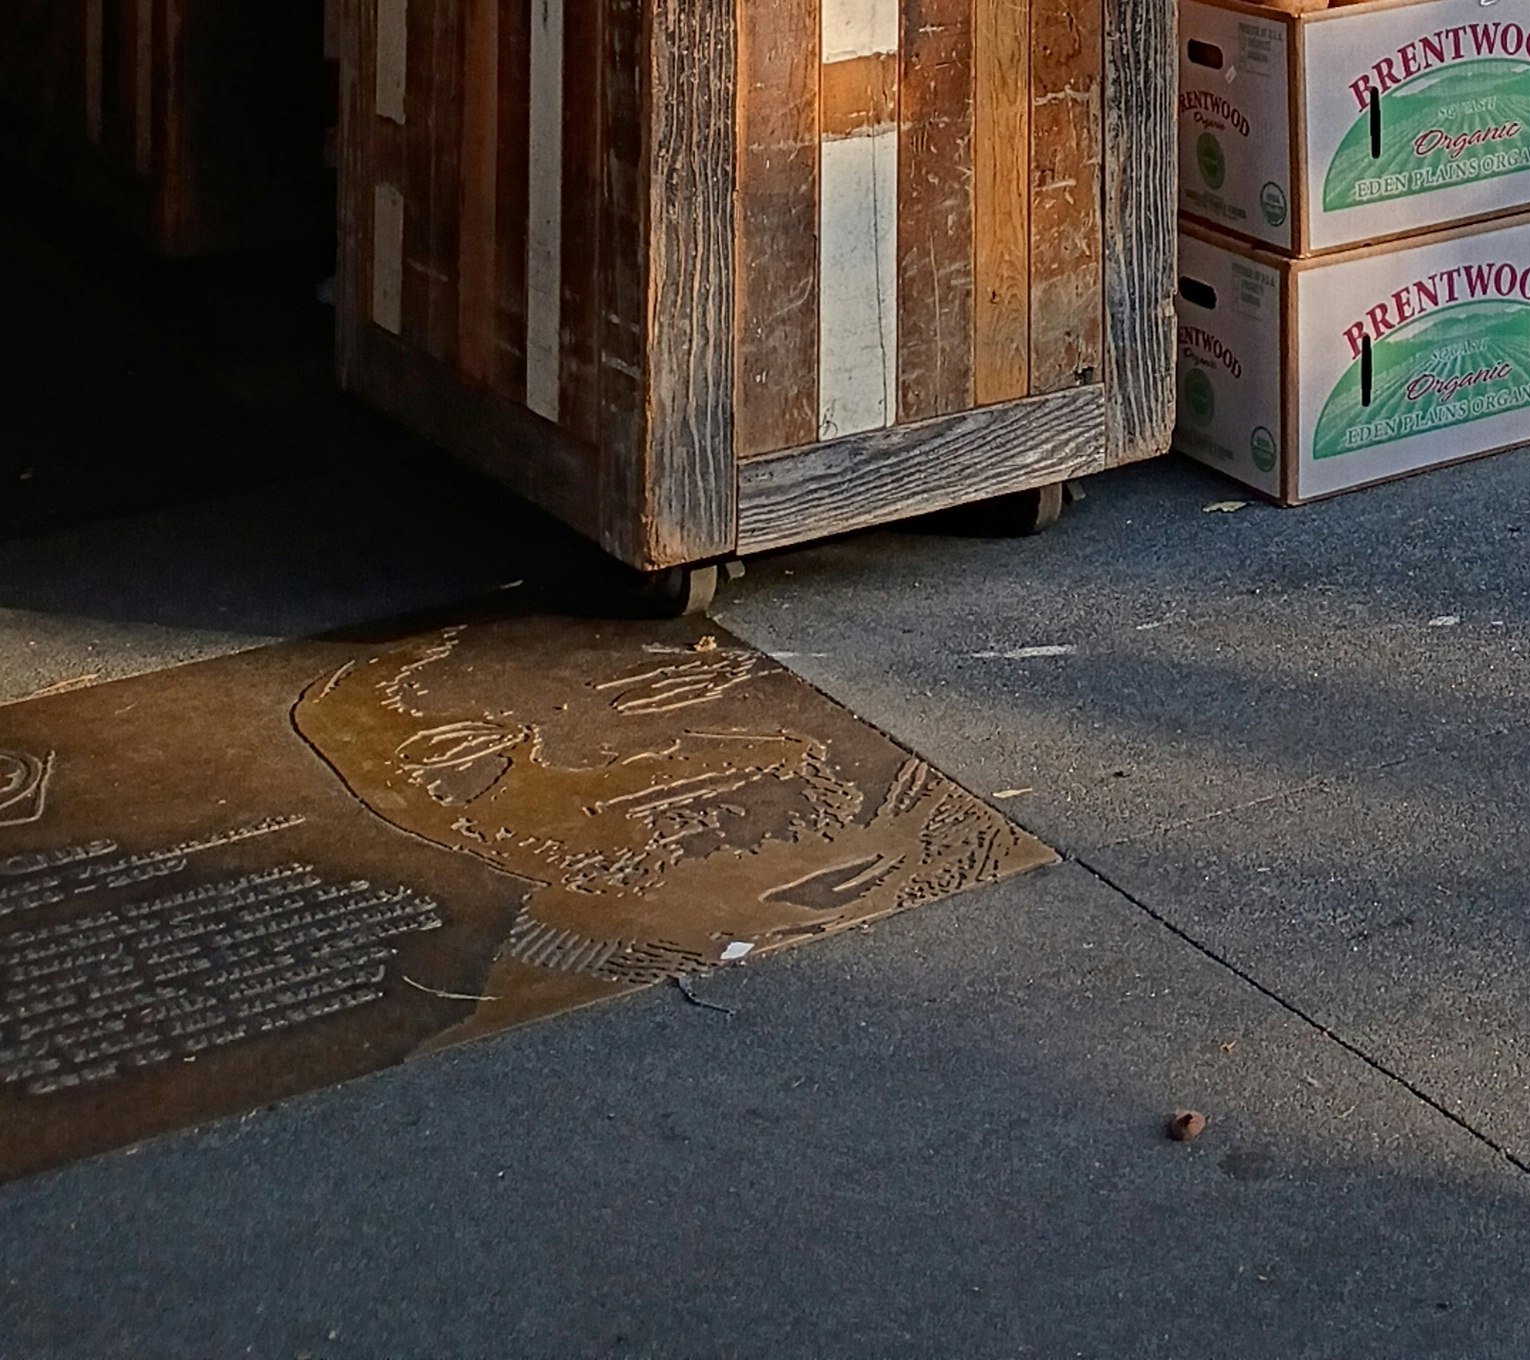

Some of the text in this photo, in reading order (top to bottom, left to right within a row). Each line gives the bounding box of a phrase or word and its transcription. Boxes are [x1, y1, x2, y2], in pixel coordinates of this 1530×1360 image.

[1414, 120, 1521, 159] Organic
[1355, 178, 1420, 201] EDEN
[1424, 161, 1480, 193] PLAINS
[1407, 361, 1513, 401] Organic
[1347, 419, 1397, 447] EDEN
[1400, 399, 1471, 436] PLAINS
